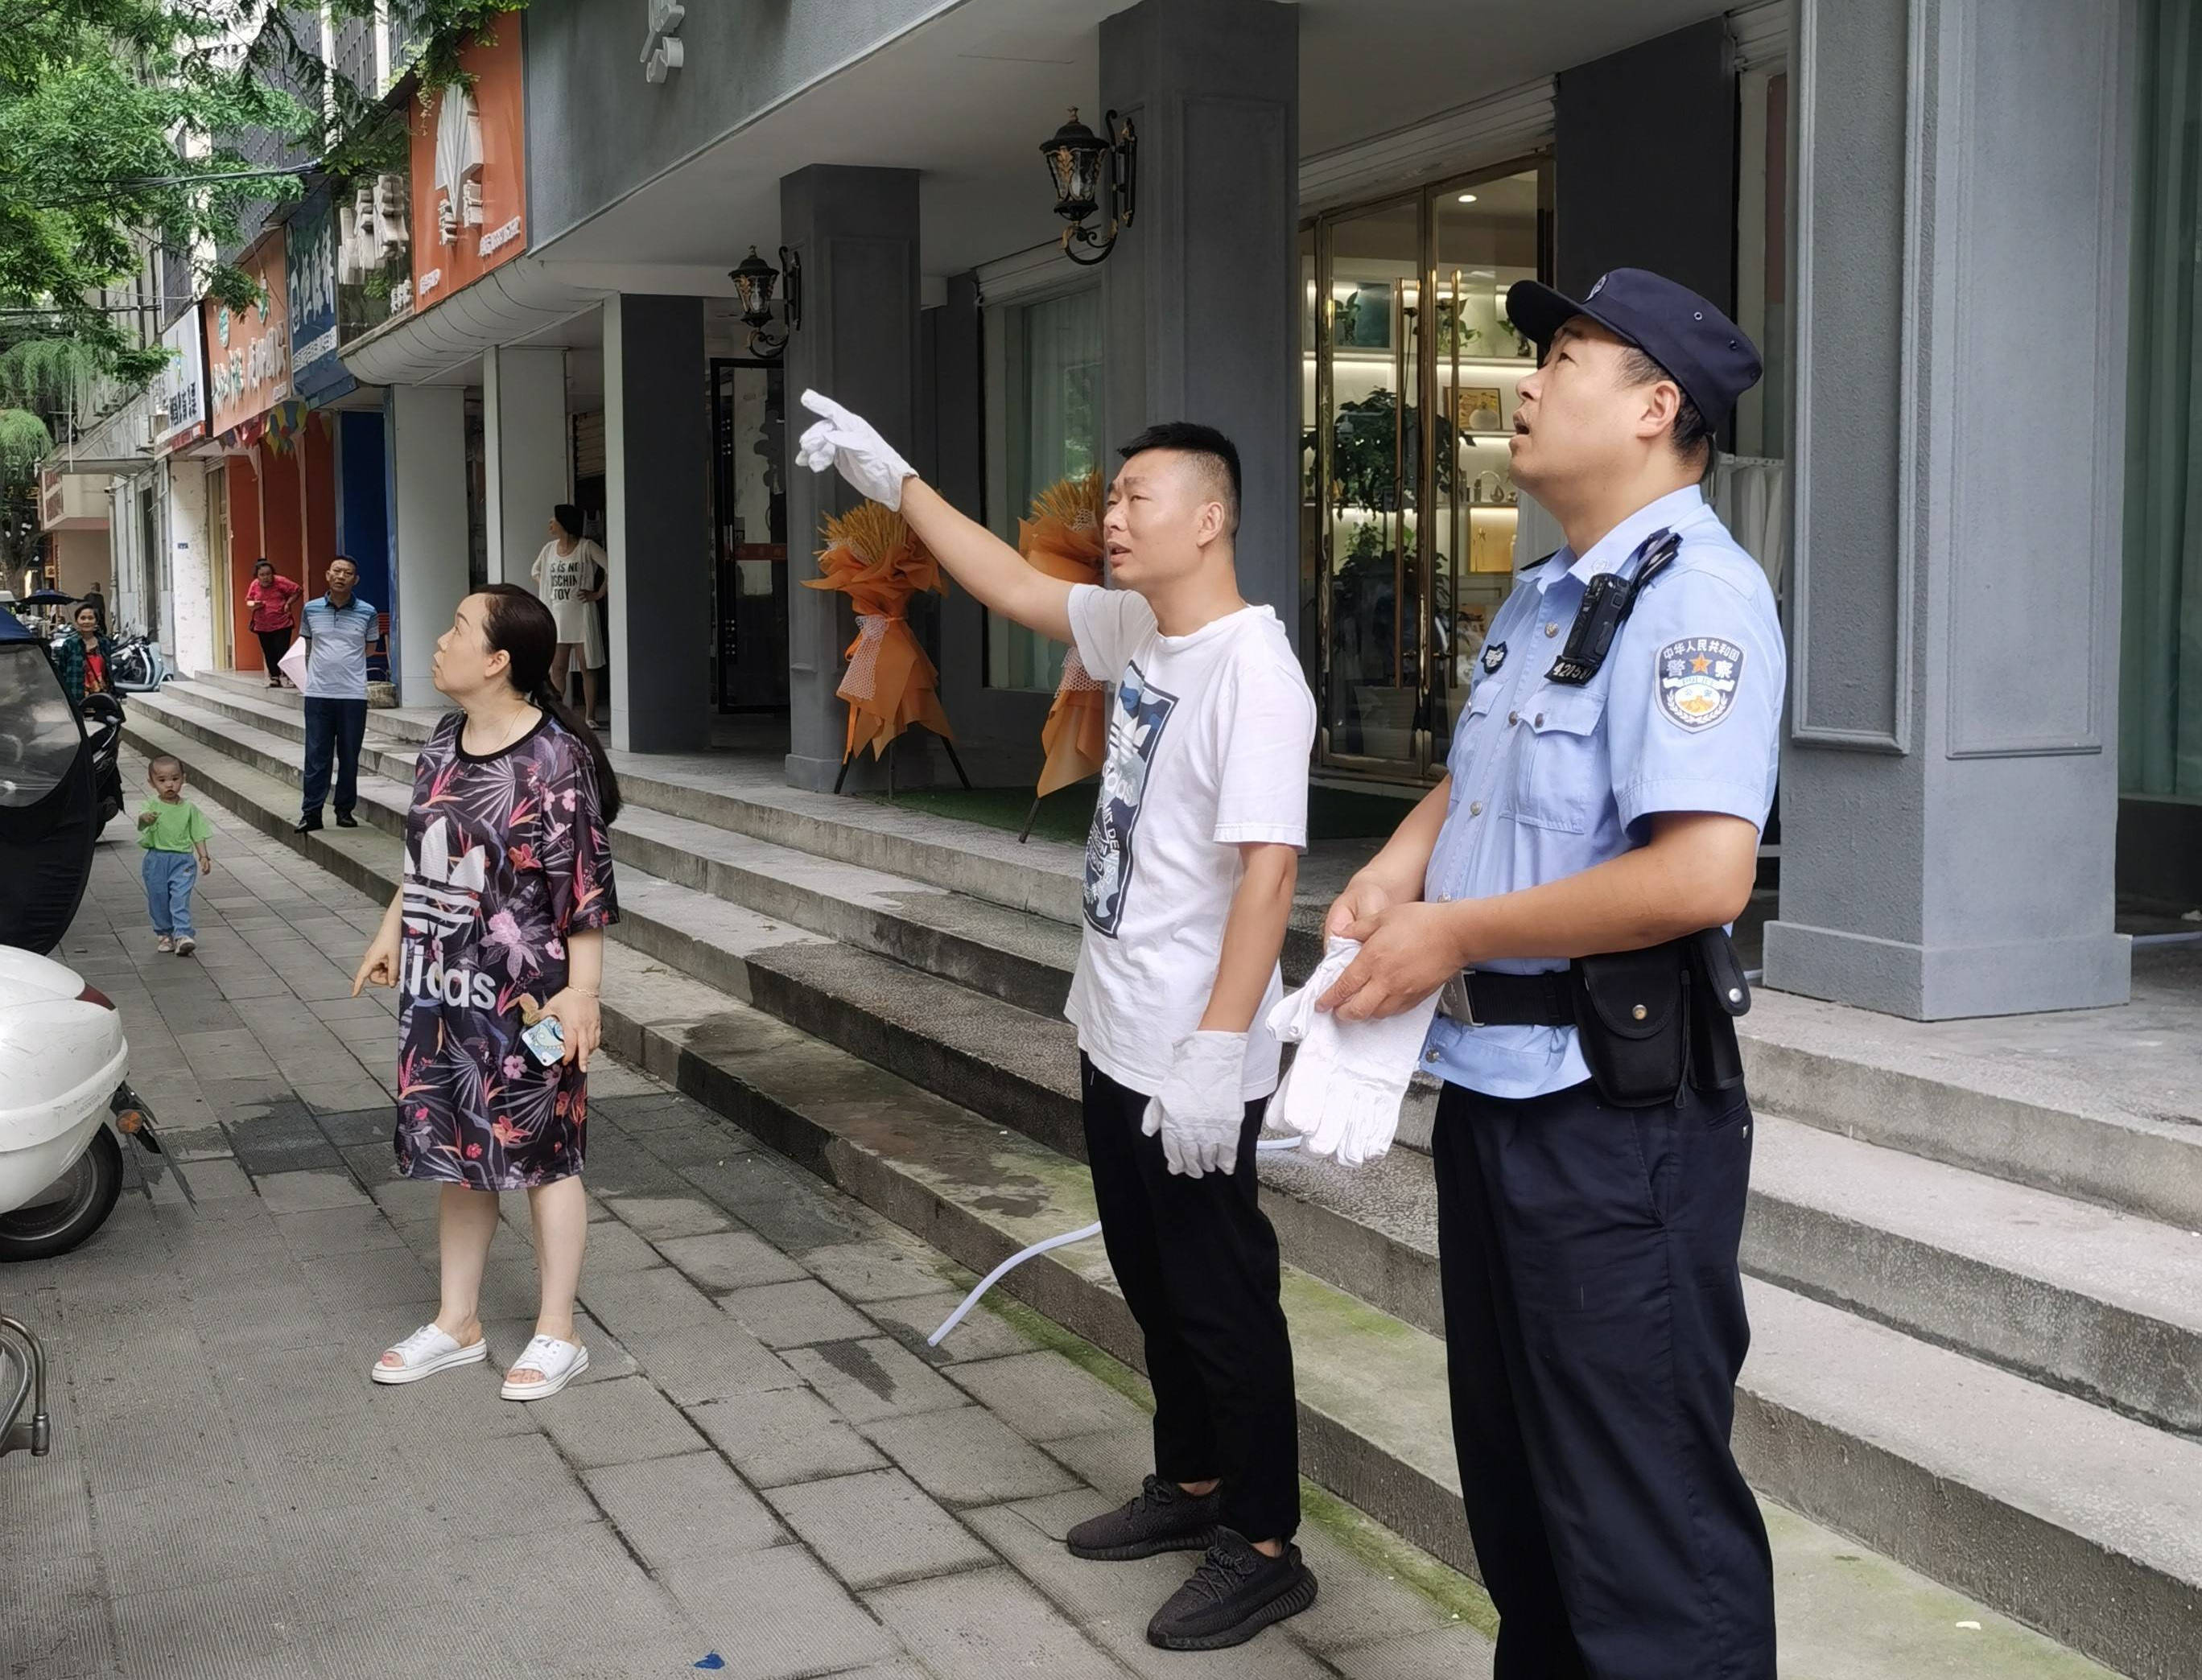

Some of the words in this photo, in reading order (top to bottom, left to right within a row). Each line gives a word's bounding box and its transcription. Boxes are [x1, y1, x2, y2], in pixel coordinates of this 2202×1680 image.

[1663, 639, 1741, 662] 中华人民共和国
